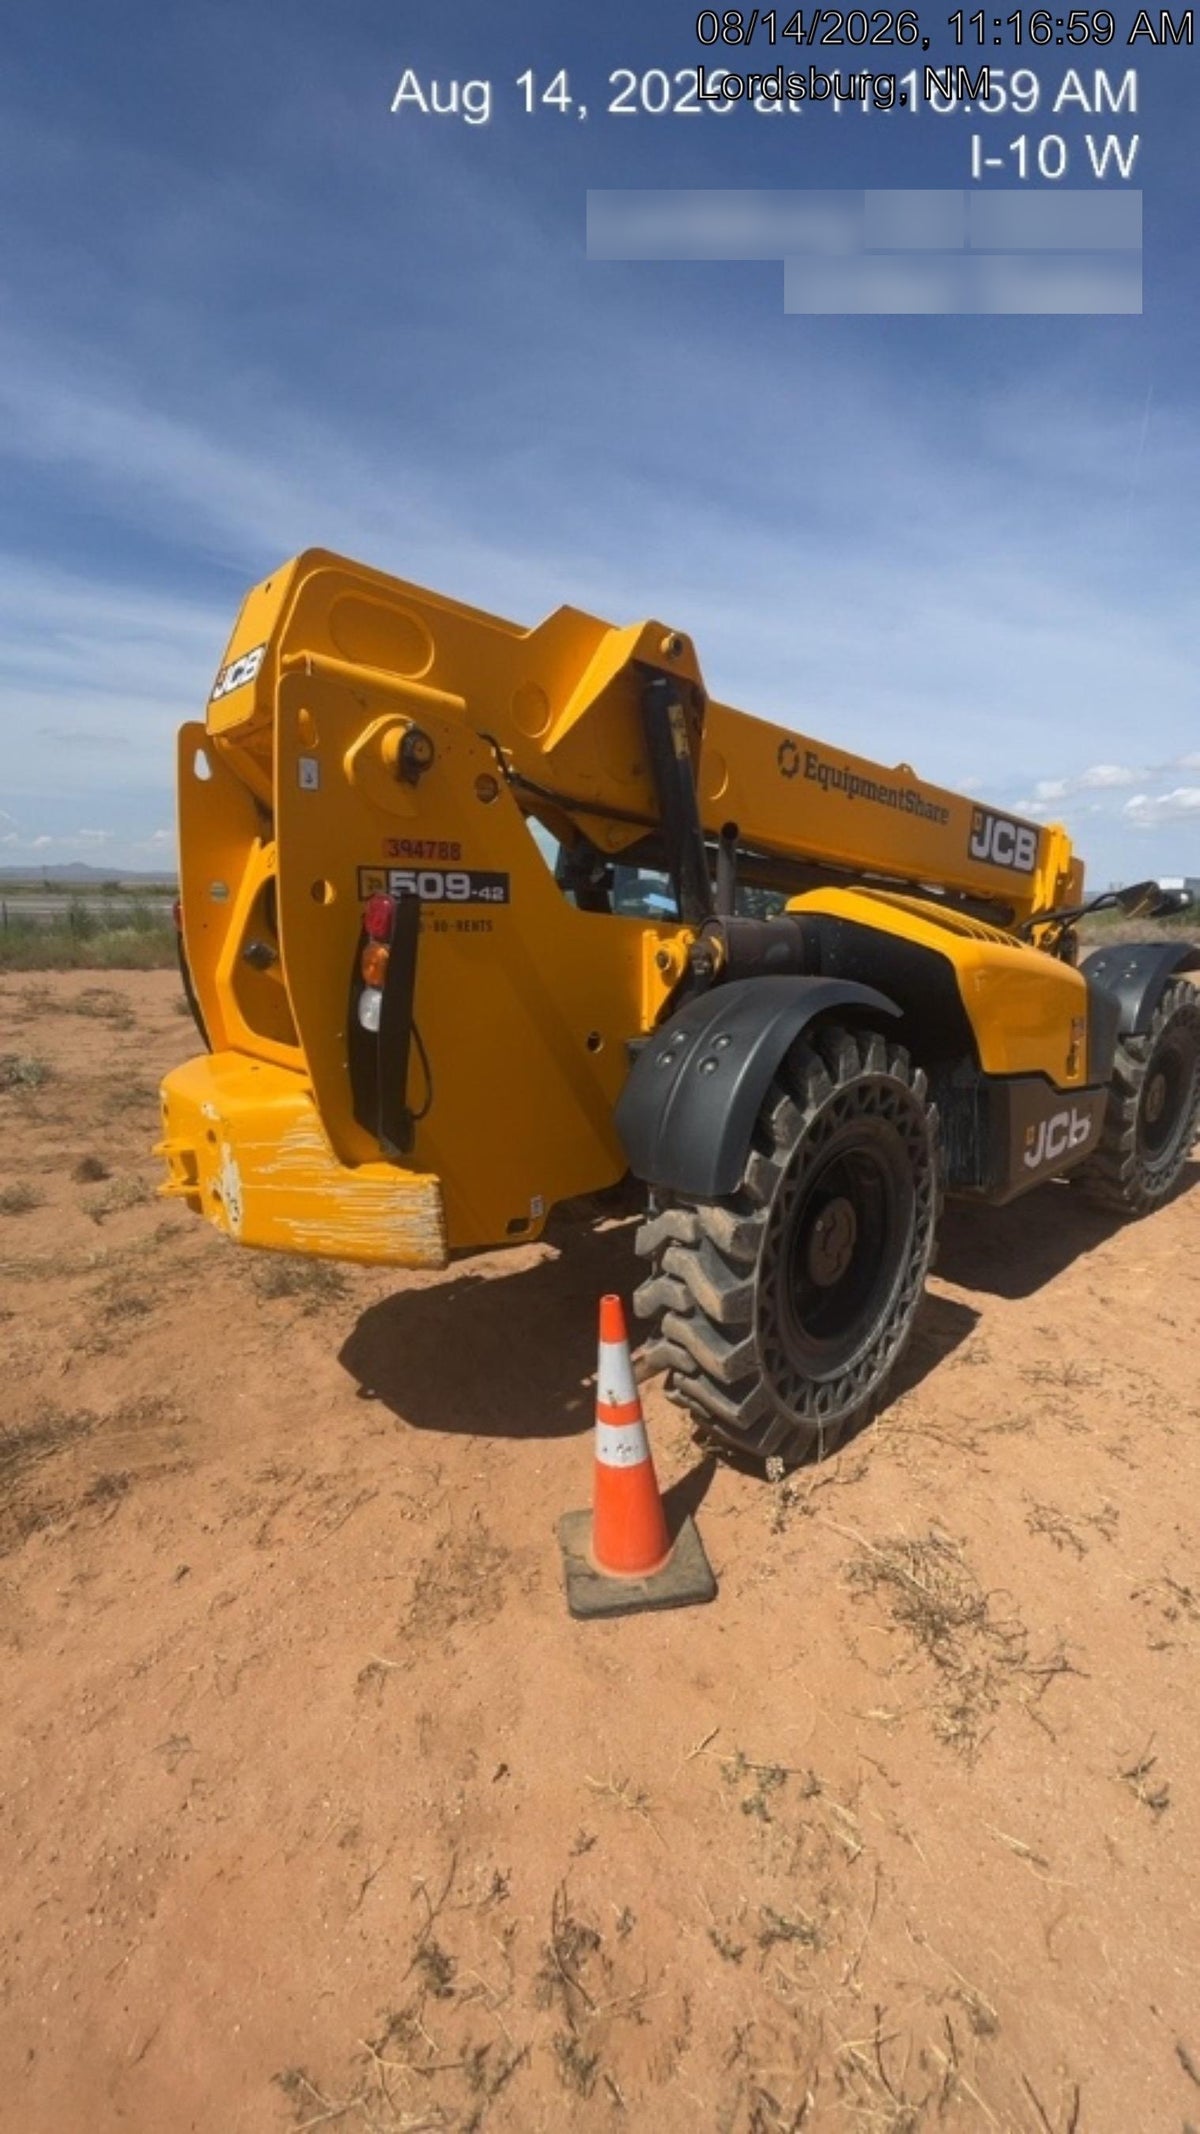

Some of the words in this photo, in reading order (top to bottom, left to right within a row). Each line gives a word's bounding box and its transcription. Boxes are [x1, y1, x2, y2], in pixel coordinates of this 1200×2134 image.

[803, 751, 949, 825] EquipmentShare
[971, 814, 1038, 872] JCB
[388, 870, 504, 901] 509-42
